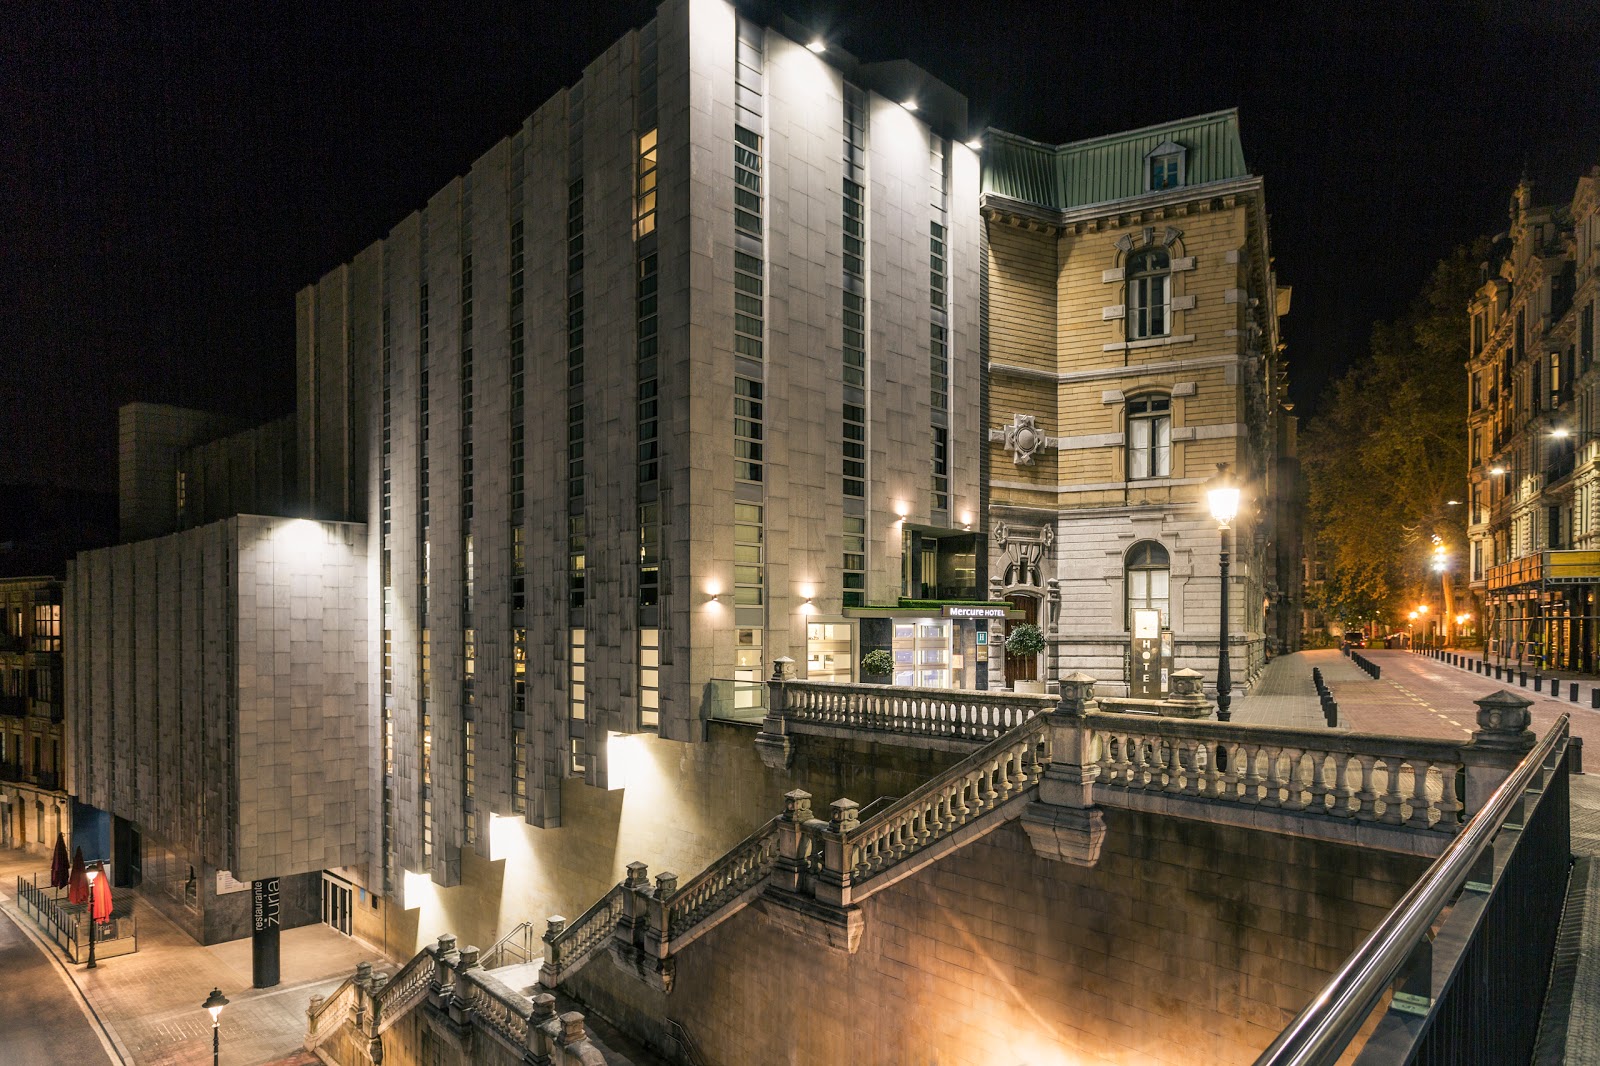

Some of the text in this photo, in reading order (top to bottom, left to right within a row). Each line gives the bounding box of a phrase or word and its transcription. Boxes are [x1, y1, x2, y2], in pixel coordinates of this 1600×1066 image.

[950, 608, 984, 616] Mercure
[1142, 640, 1151, 694] HOTEL
[254, 881, 263, 931] restaurante
